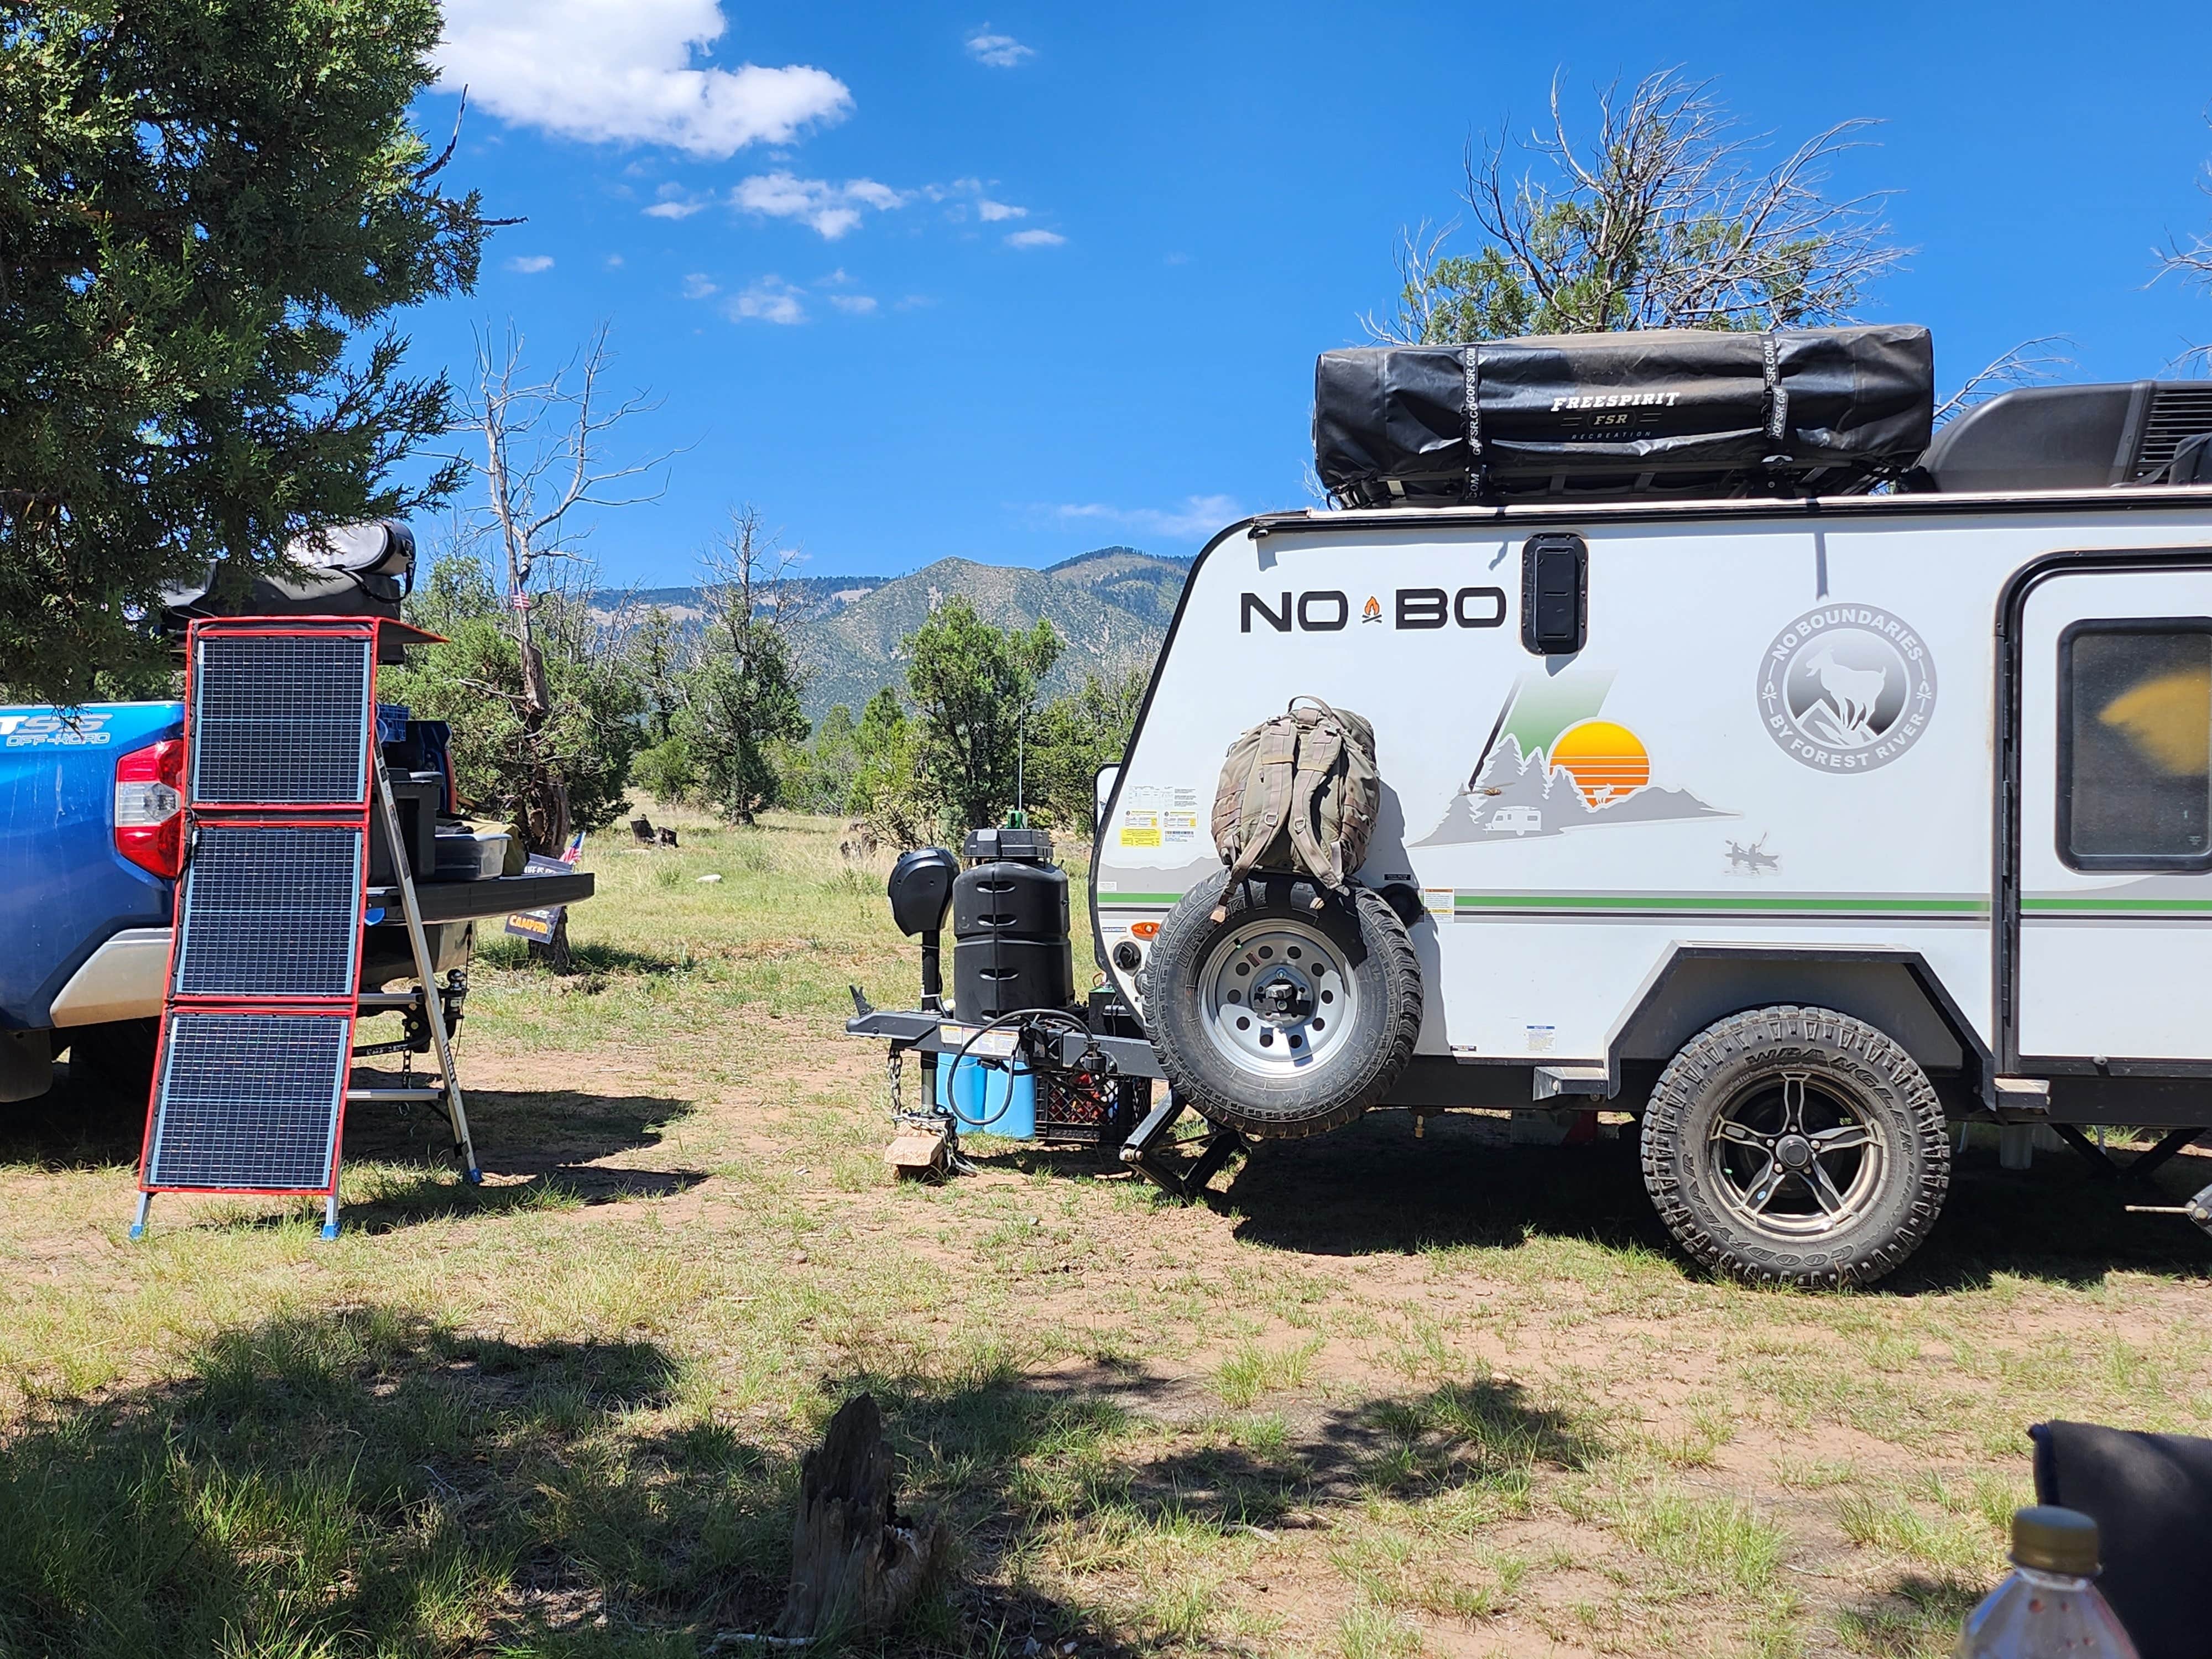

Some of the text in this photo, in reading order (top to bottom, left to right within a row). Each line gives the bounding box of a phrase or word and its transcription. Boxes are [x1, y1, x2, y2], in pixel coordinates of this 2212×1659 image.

[1466, 348, 1476, 403] GOFSR.COM
[1551, 392, 1680, 411] FREESPIRIT
[1469, 404, 1481, 456] GOFSR.CO
[1571, 431, 1651, 440] RECREATION
[1594, 414, 1628, 425] FSR
[1241, 587, 1506, 633] NO BO
[1771, 609, 1923, 661] NO BOUNDARIES
[6, 732, 111, 747] OFF-ROAD
[1770, 713, 1924, 768] BY FOREST RIVER
[1744, 1047, 1915, 1156] WRANGLER
[1683, 1154, 1853, 1266] GOODYEAR
